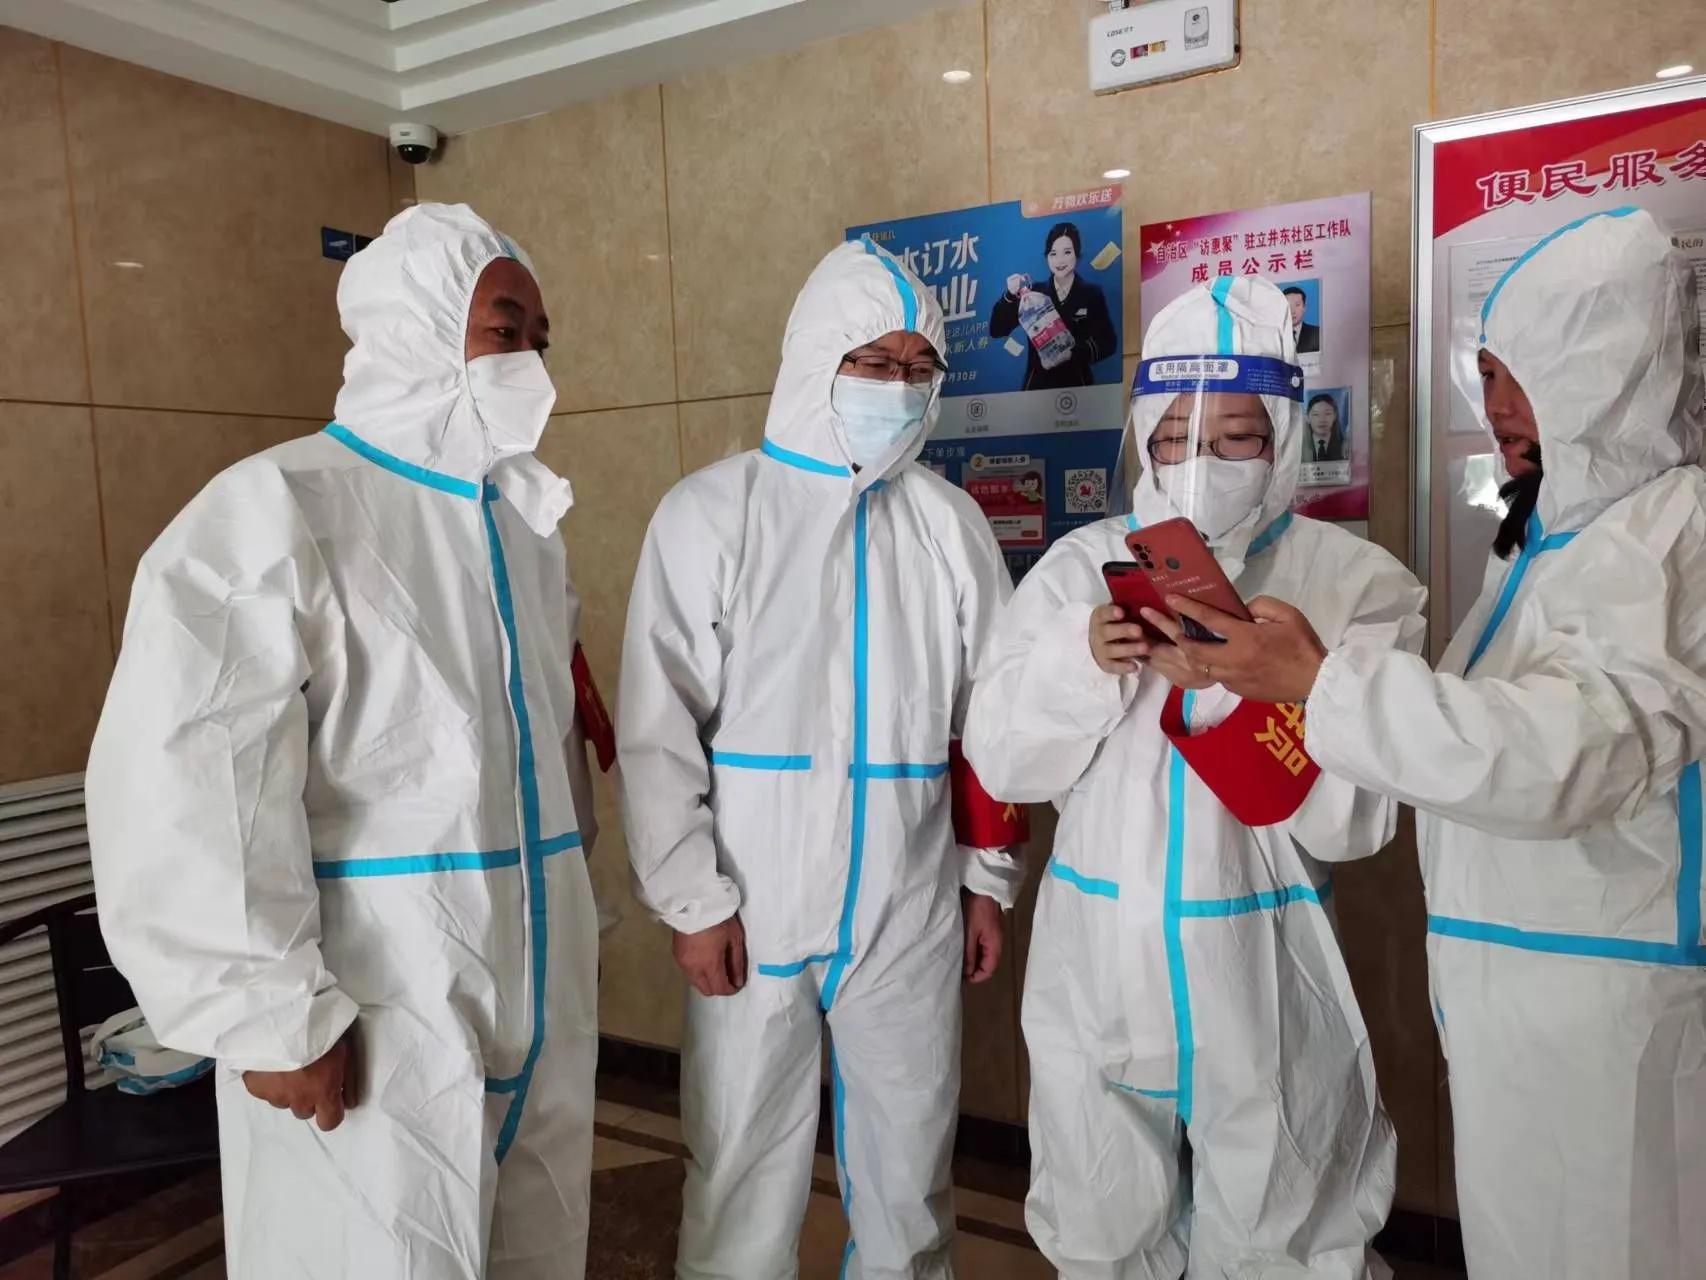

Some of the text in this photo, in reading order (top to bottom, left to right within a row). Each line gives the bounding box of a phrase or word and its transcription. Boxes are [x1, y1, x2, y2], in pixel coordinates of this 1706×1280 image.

[1477, 141, 1706, 211] 便民服务
[1191, 248, 1314, 283] 成员公示栏
[927, 272, 978, 323] 业
[974, 456, 982, 468] 2
